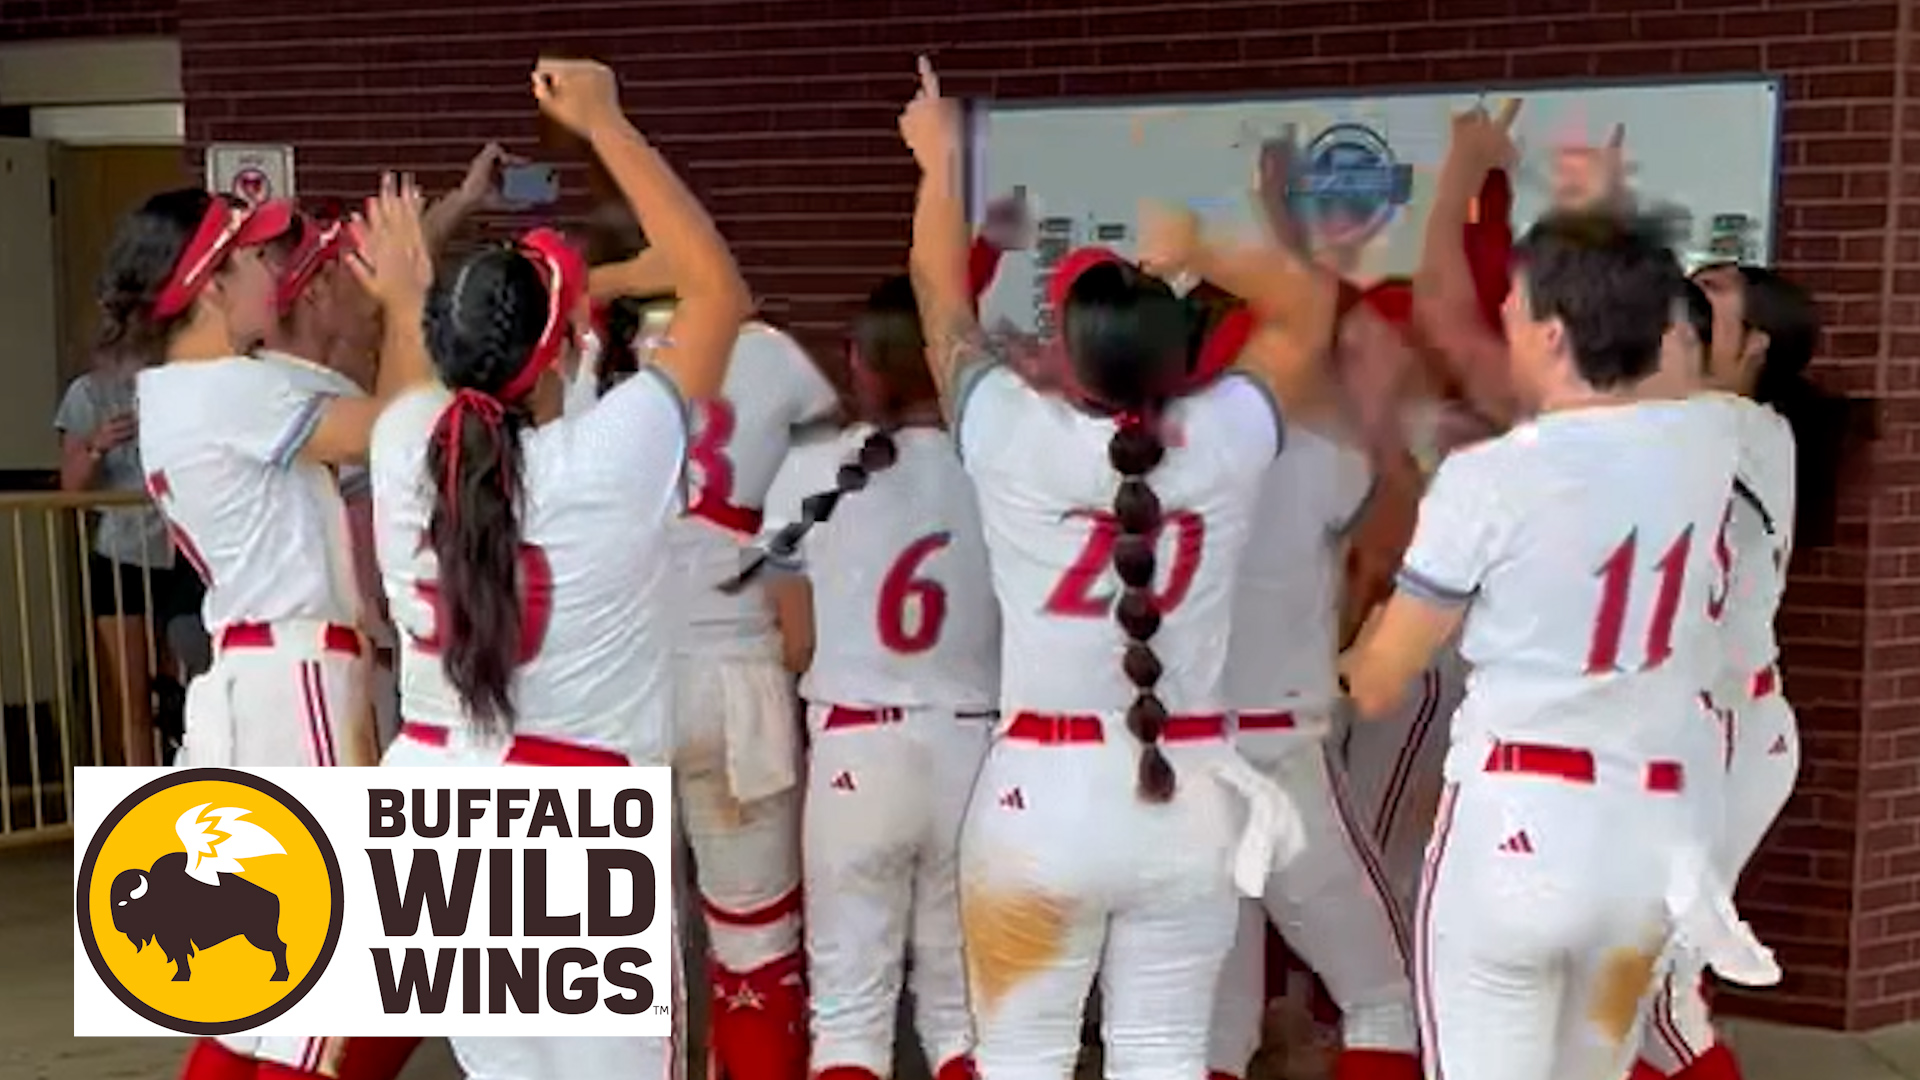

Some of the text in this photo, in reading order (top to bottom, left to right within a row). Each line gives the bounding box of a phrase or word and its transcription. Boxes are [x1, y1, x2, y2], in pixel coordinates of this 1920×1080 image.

[876, 530, 952, 655] 6
[1043, 508, 1205, 619] 20
[1583, 524, 1694, 675] 11
